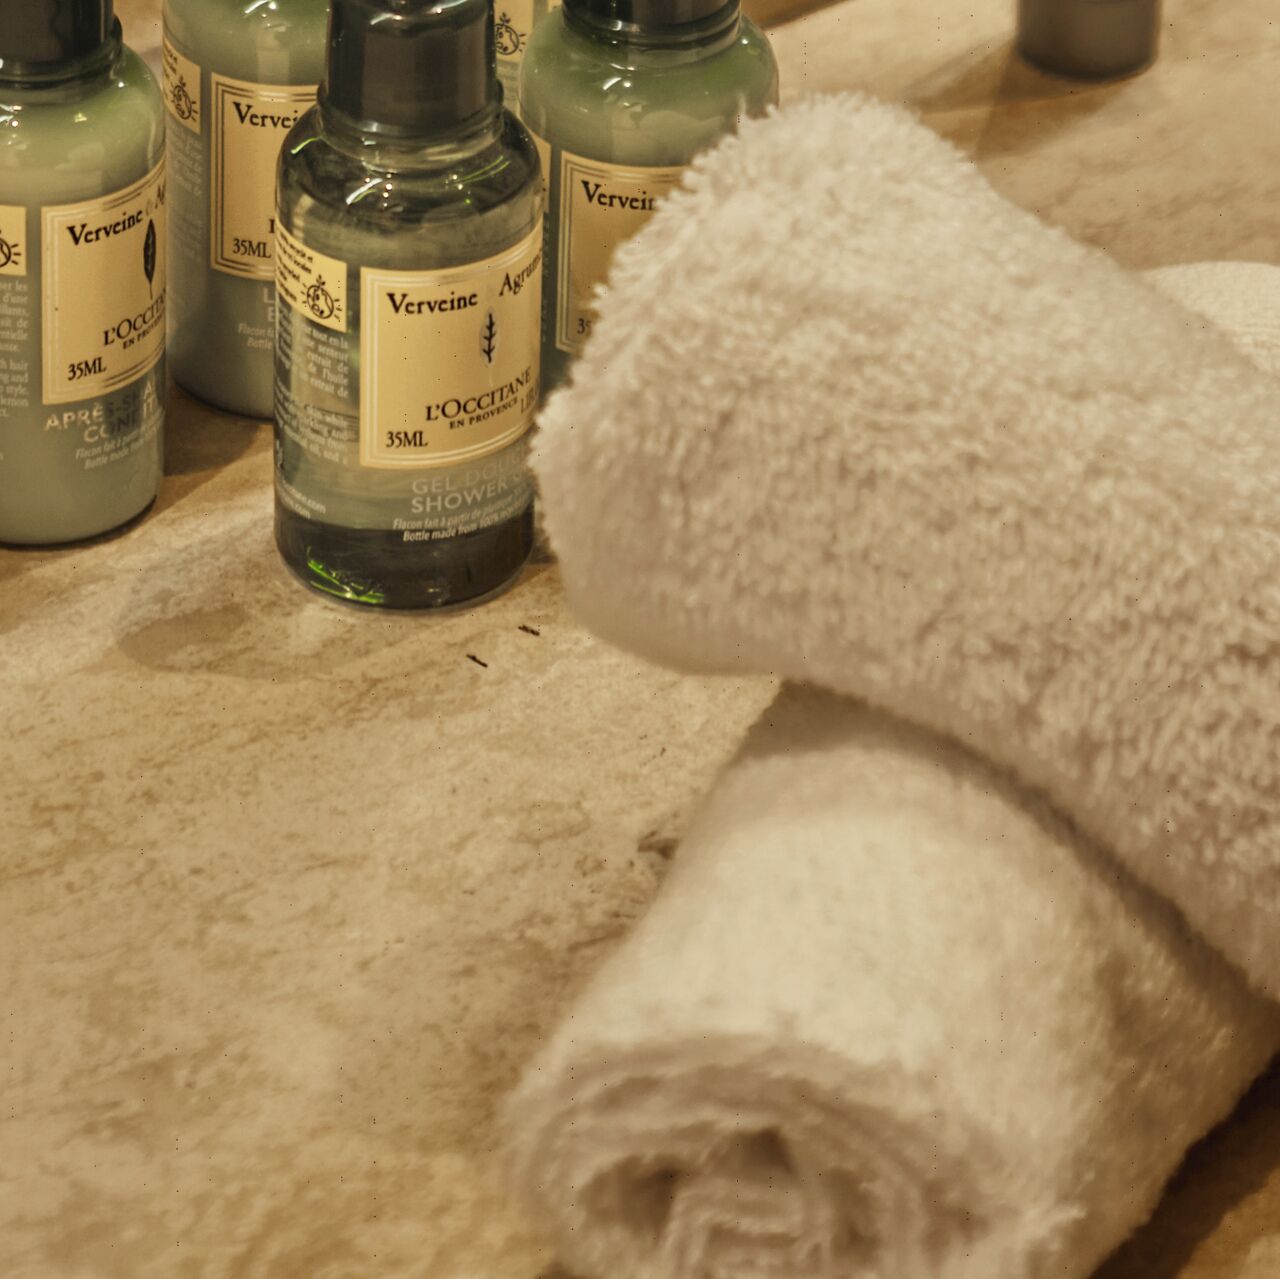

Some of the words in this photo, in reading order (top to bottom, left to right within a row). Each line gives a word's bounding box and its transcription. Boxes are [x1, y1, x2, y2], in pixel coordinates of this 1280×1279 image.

[67, 210, 143, 246] Verveine
[232, 237, 272, 259] 35ML
[386, 290, 479, 316] Verveine
[67, 356, 107, 381] 35ML
[424, 365, 532, 422] L'OCCITANE
[448, 418, 466, 431] EN
[468, 394, 520, 427] PROVENCE
[385, 430, 429, 450] 35ML
[410, 473, 508, 514] SHOWER
[411, 477, 457, 495] GEL
[392, 517, 422, 531] Flacon
[402, 529, 431, 543] Bottle
[431, 525, 457, 540] made
